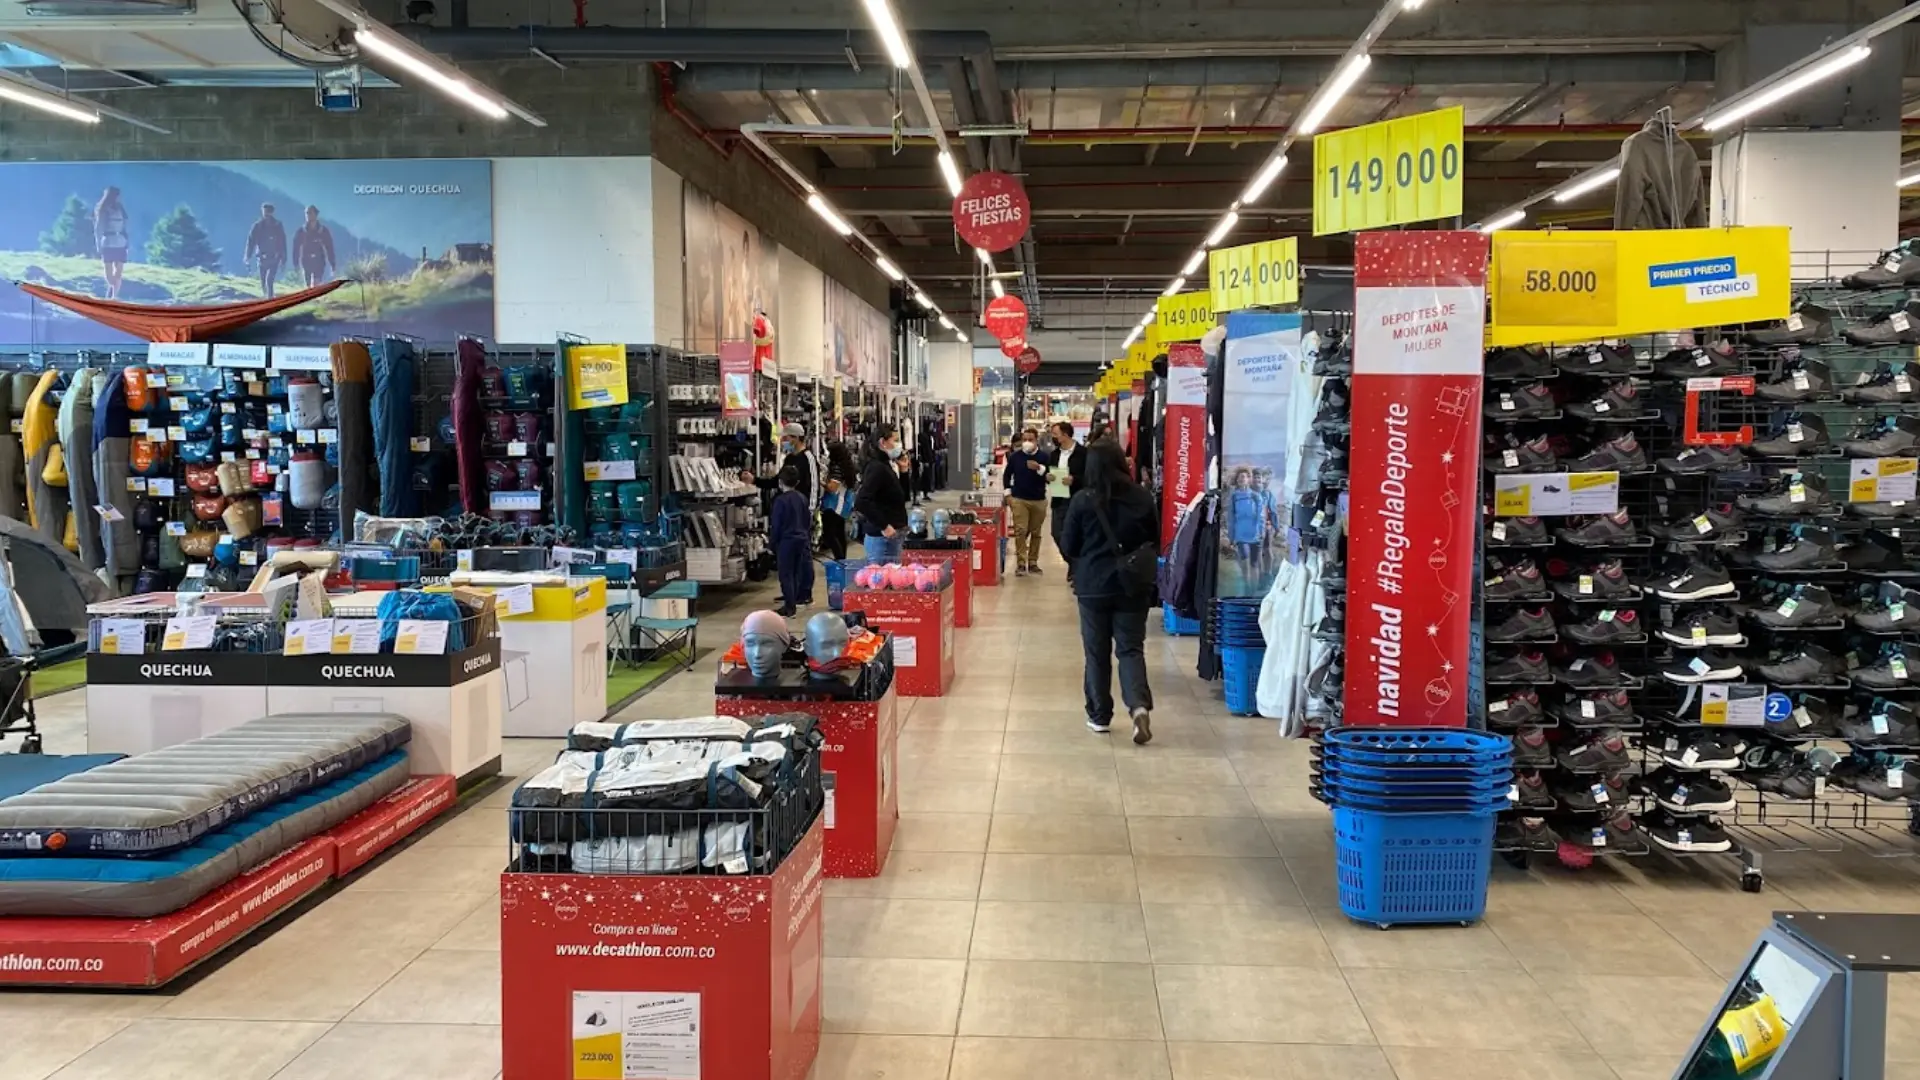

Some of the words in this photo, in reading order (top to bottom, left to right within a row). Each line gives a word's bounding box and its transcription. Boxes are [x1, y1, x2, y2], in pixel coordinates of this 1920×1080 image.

[409, 184, 461, 194] QUECHUA
[960, 193, 1011, 215] FELICES
[972, 207, 1022, 228] FIESTAS
[1652, 266, 1692, 280] PRIMER
[1693, 262, 1732, 276] PRECIO
[1526, 270, 1596, 293] 58.000
[1699, 281, 1750, 297] TÉCNICO
[1382, 306, 1439, 326] DEPORTES
[1441, 303, 1456, 316] DE
[1393, 320, 1448, 340] MONTAÑA
[1404, 337, 1442, 353] MUJER
[1237, 355, 1277, 366] DEPORTES
[1278, 353, 1288, 362] DE
[1244, 363, 1283, 375] MONTAÑA
[1377, 402, 1413, 595] #RegalaDeporte
[463, 652, 492, 673] QUECHUA
[1370, 603, 1402, 718] navidad
[140, 663, 213, 677] QUECHUA
[321, 665, 395, 679] QUECHUA
[180, 930, 206, 954] compra
[205, 927, 215, 939] en
[242, 857, 324, 914] www.decathlon.com.co
[593, 923, 634, 938] Compra
[636, 926, 650, 936] en
[556, 941, 715, 958] www.decathlon.com.co
[0, 953, 103, 971] thlon.com.co
